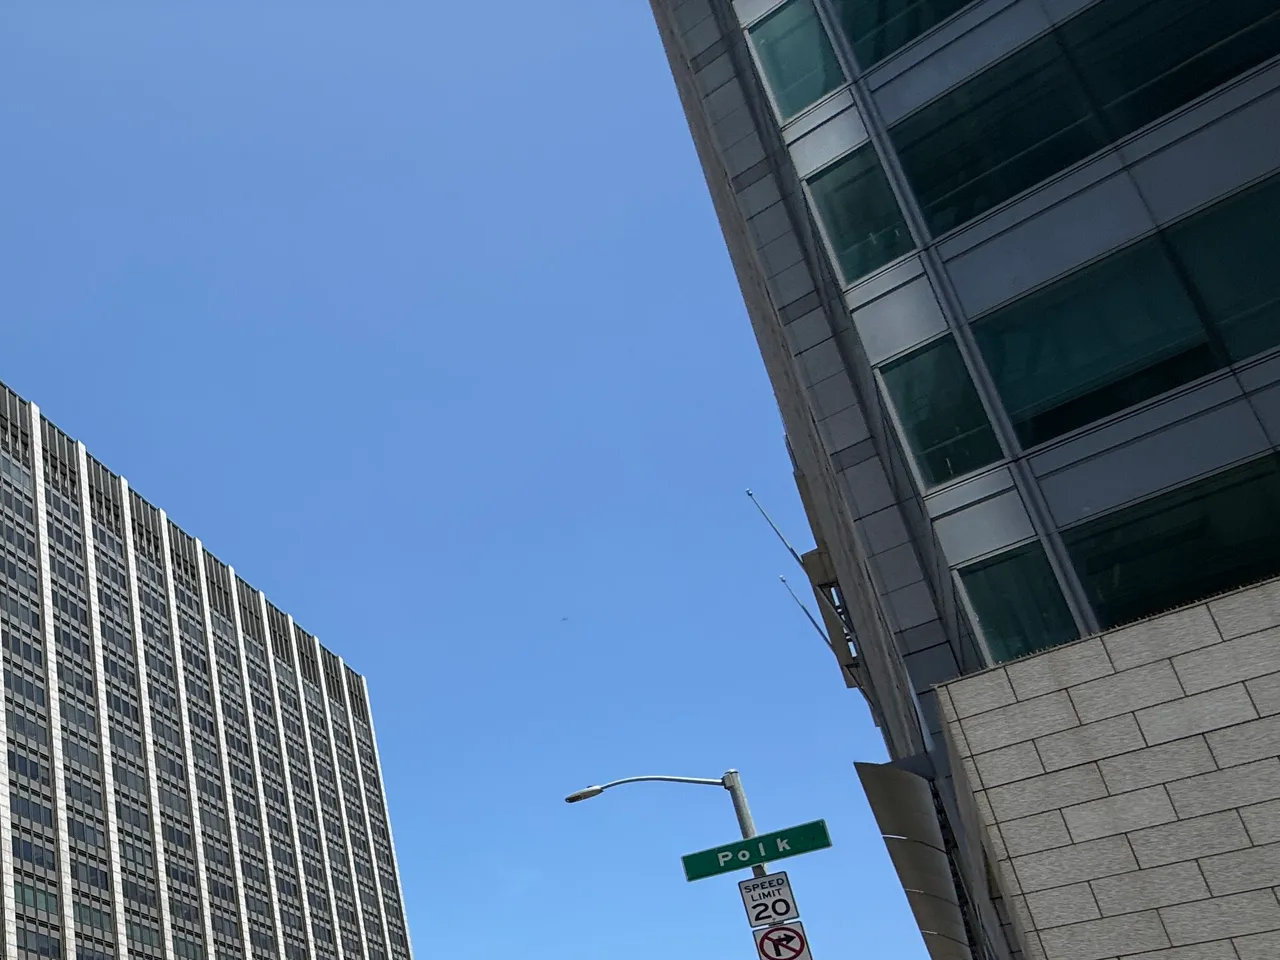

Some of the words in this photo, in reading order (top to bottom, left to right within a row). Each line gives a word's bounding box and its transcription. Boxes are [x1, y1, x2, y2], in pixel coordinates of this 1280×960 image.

[717, 838, 791, 867] Polk
[744, 878, 785, 894] SPEED
[751, 888, 782, 902] LIMIT
[751, 898, 791, 922] 20
